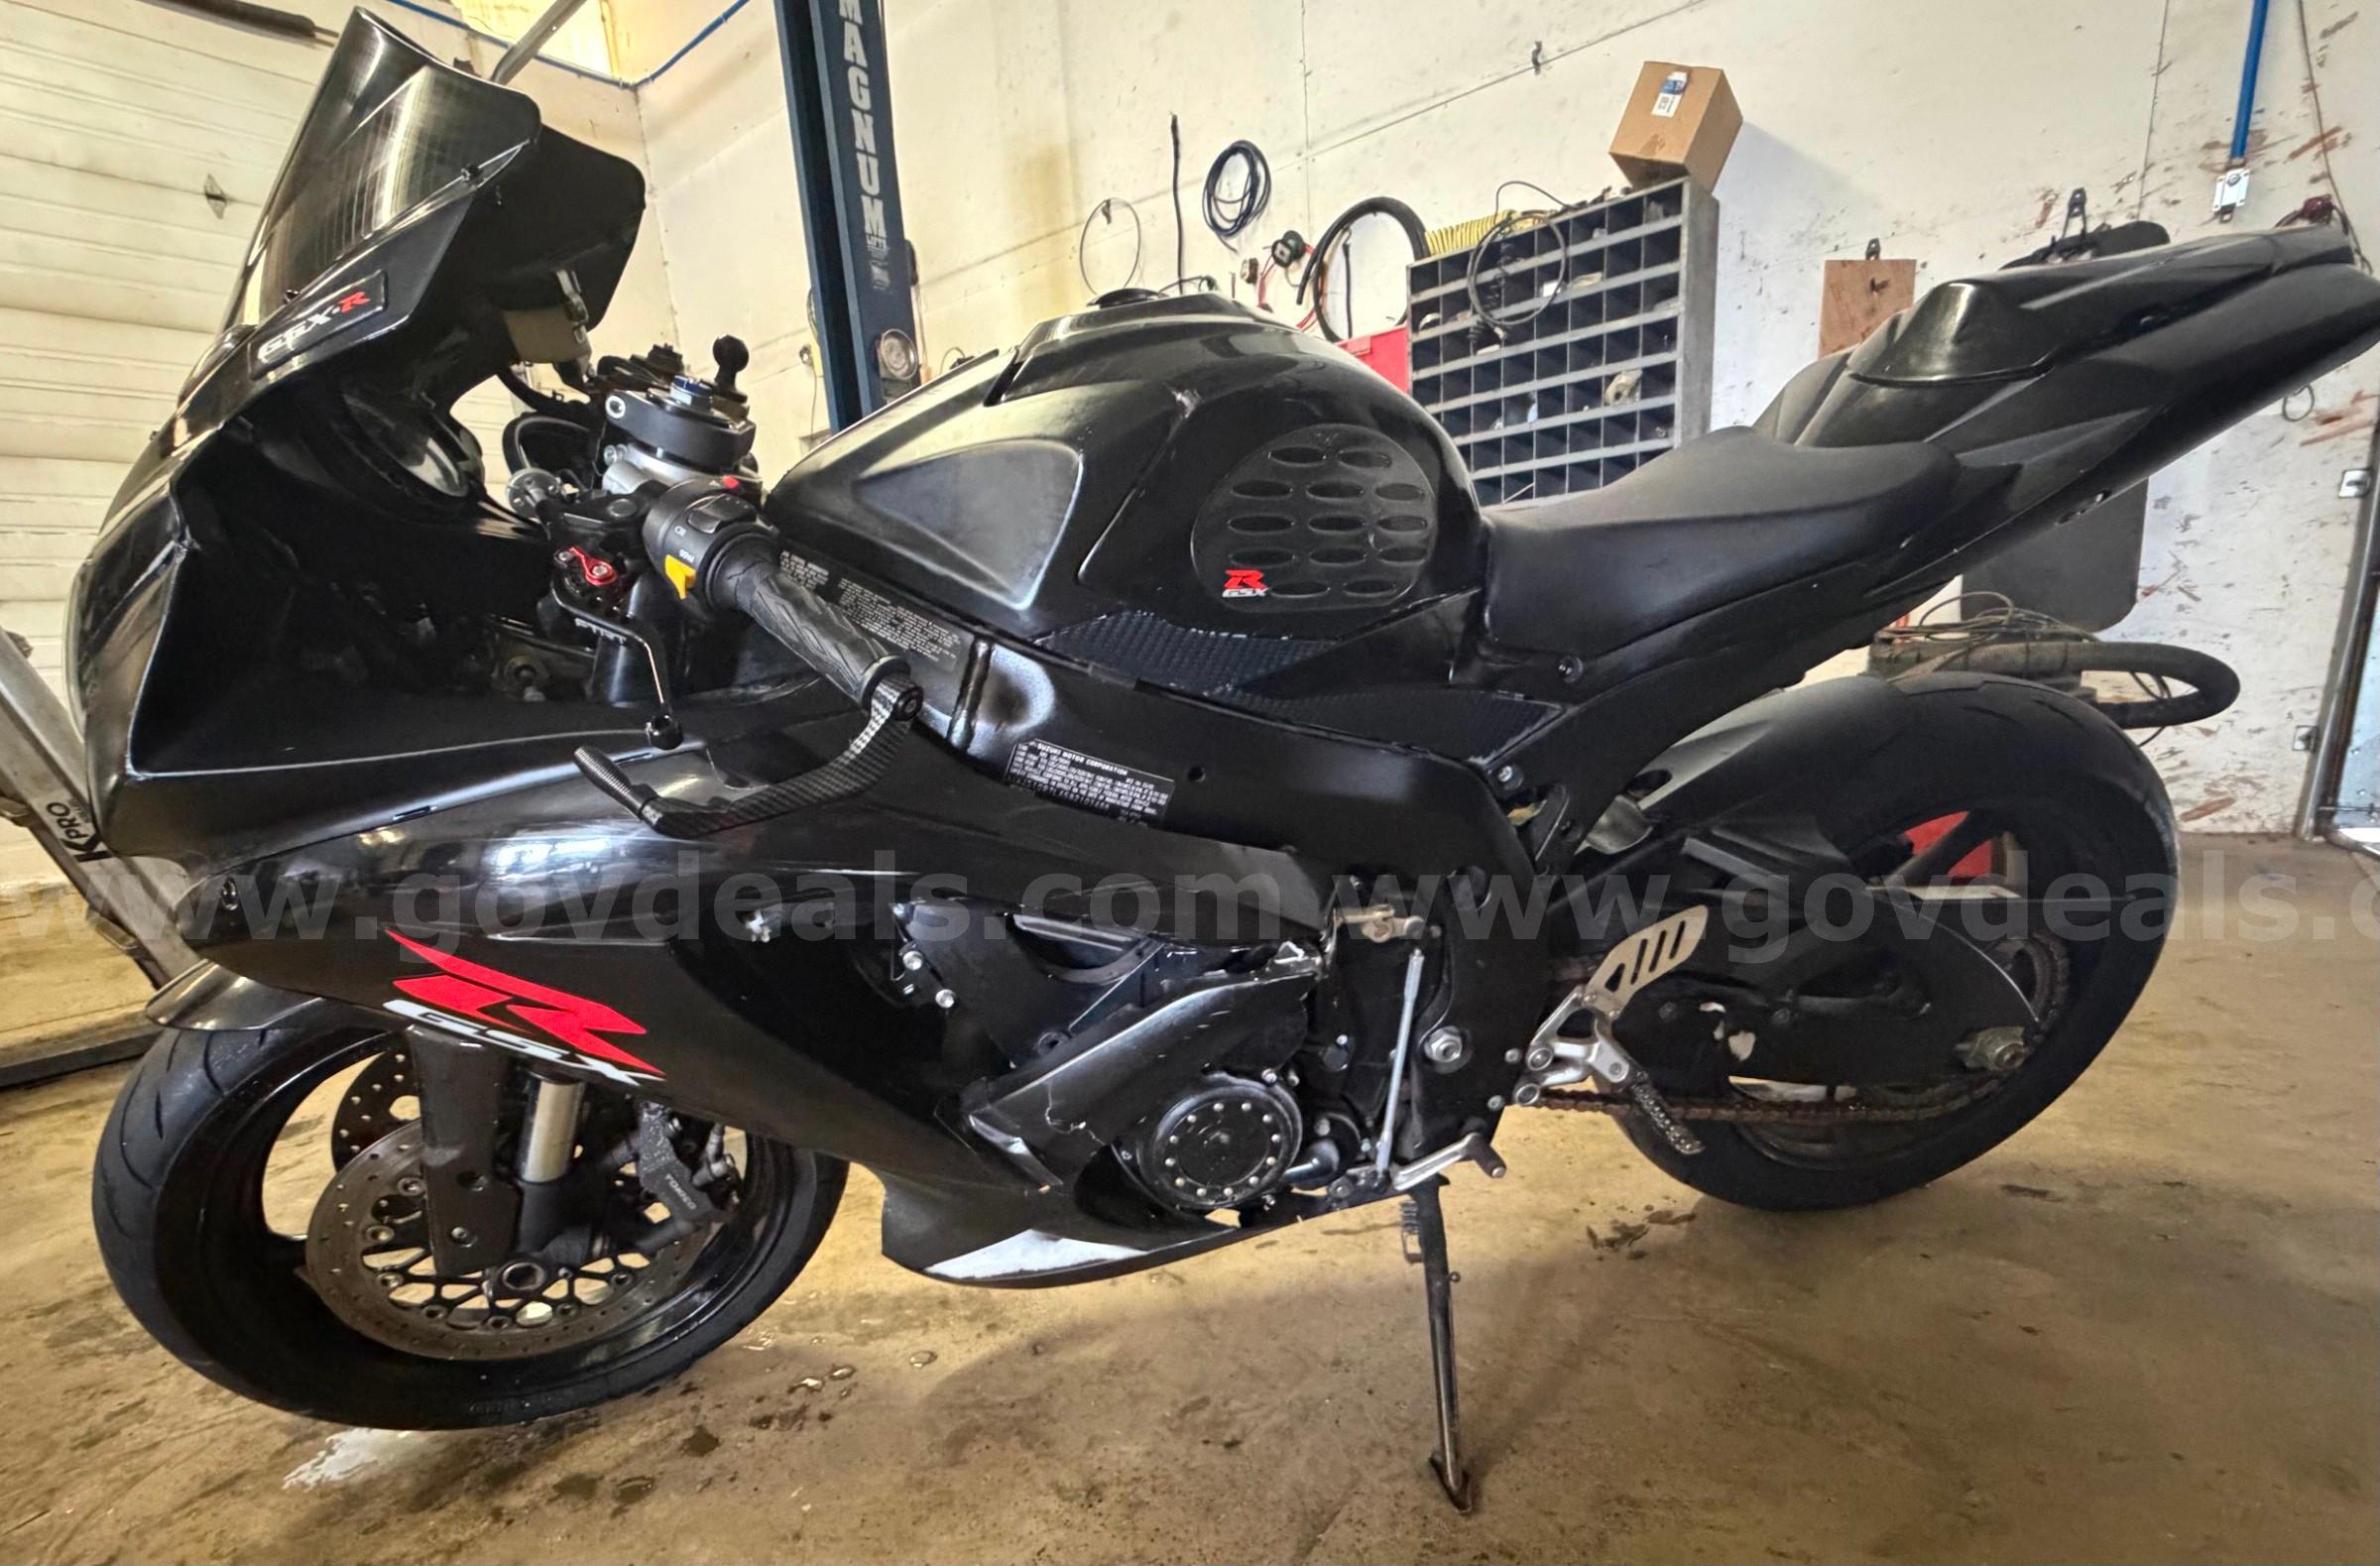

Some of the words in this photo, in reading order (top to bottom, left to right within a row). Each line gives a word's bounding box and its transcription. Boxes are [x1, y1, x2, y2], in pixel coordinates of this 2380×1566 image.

[1037, 743, 1062, 756] SUZUKI
[1062, 751, 1085, 764] MOTOR
[1086, 758, 1129, 776] CORPORATION
[383, 999, 667, 1087] GSX
